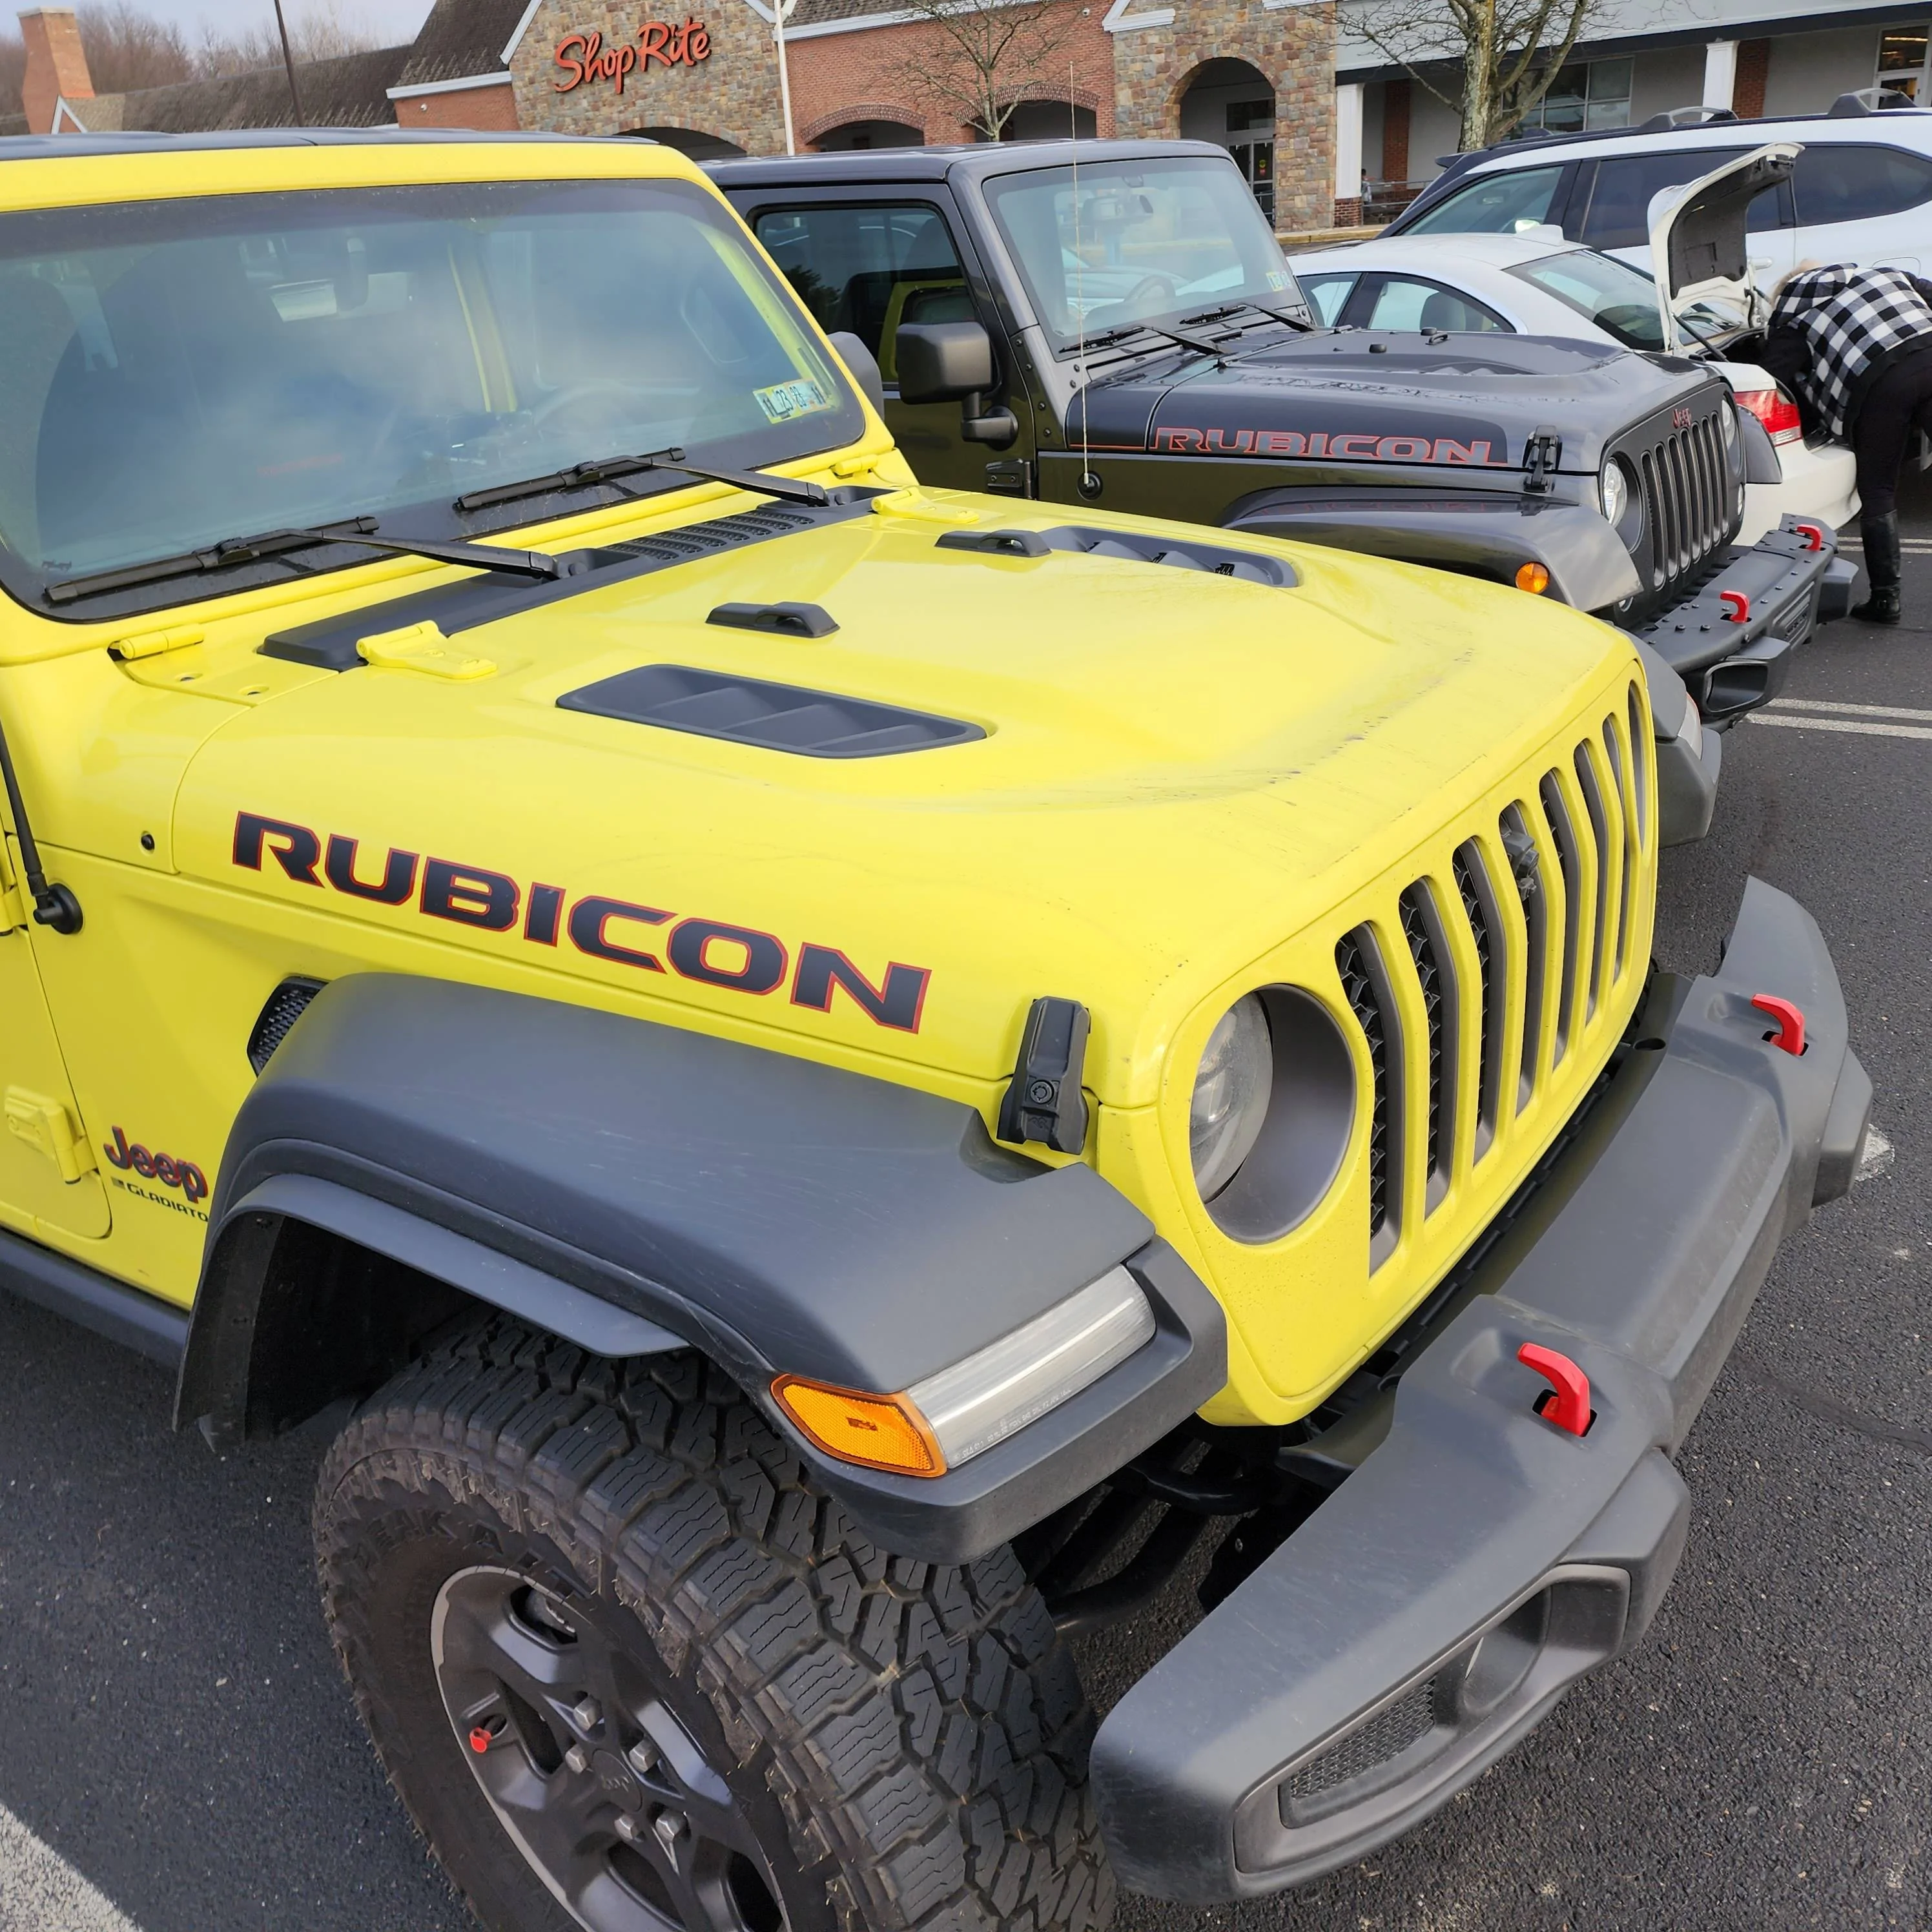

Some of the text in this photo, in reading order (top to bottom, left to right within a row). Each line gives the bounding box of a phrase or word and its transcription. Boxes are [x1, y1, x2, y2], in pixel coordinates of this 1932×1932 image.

[1154, 427, 1493, 465] RUBICON
[231, 811, 932, 1034] RUBICON
[103, 1125, 209, 1204] Jeep
[127, 1183, 209, 1222] GLADIATO
